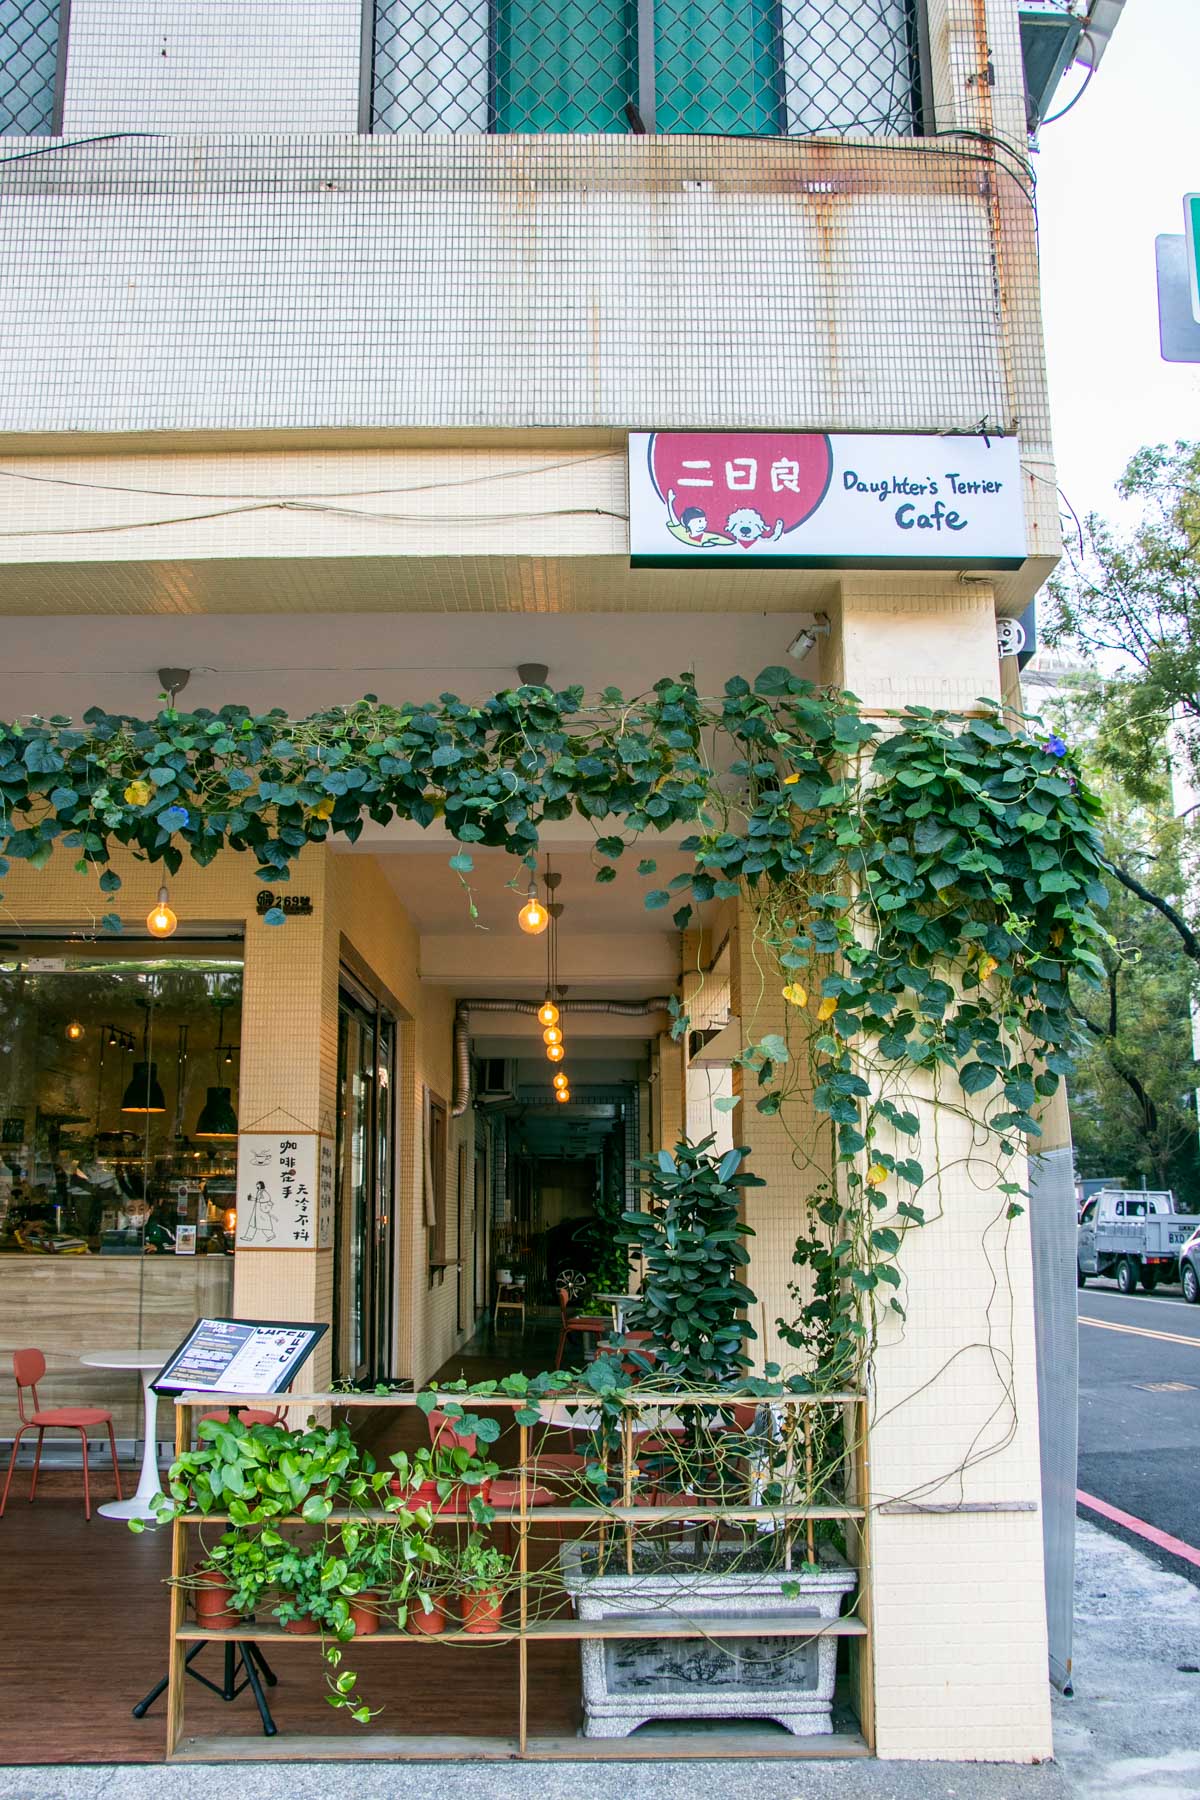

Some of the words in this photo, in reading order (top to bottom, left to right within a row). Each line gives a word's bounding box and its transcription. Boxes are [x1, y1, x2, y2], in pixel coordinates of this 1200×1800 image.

[677, 457, 800, 493] 二日良
[843, 470, 939, 502] Daughter's
[945, 473, 1003, 495] Terrier
[895, 500, 968, 531] Cafe
[279, 1139, 298, 1200] 咖啡在手
[292, 1183, 310, 1242] 天冷不抖
